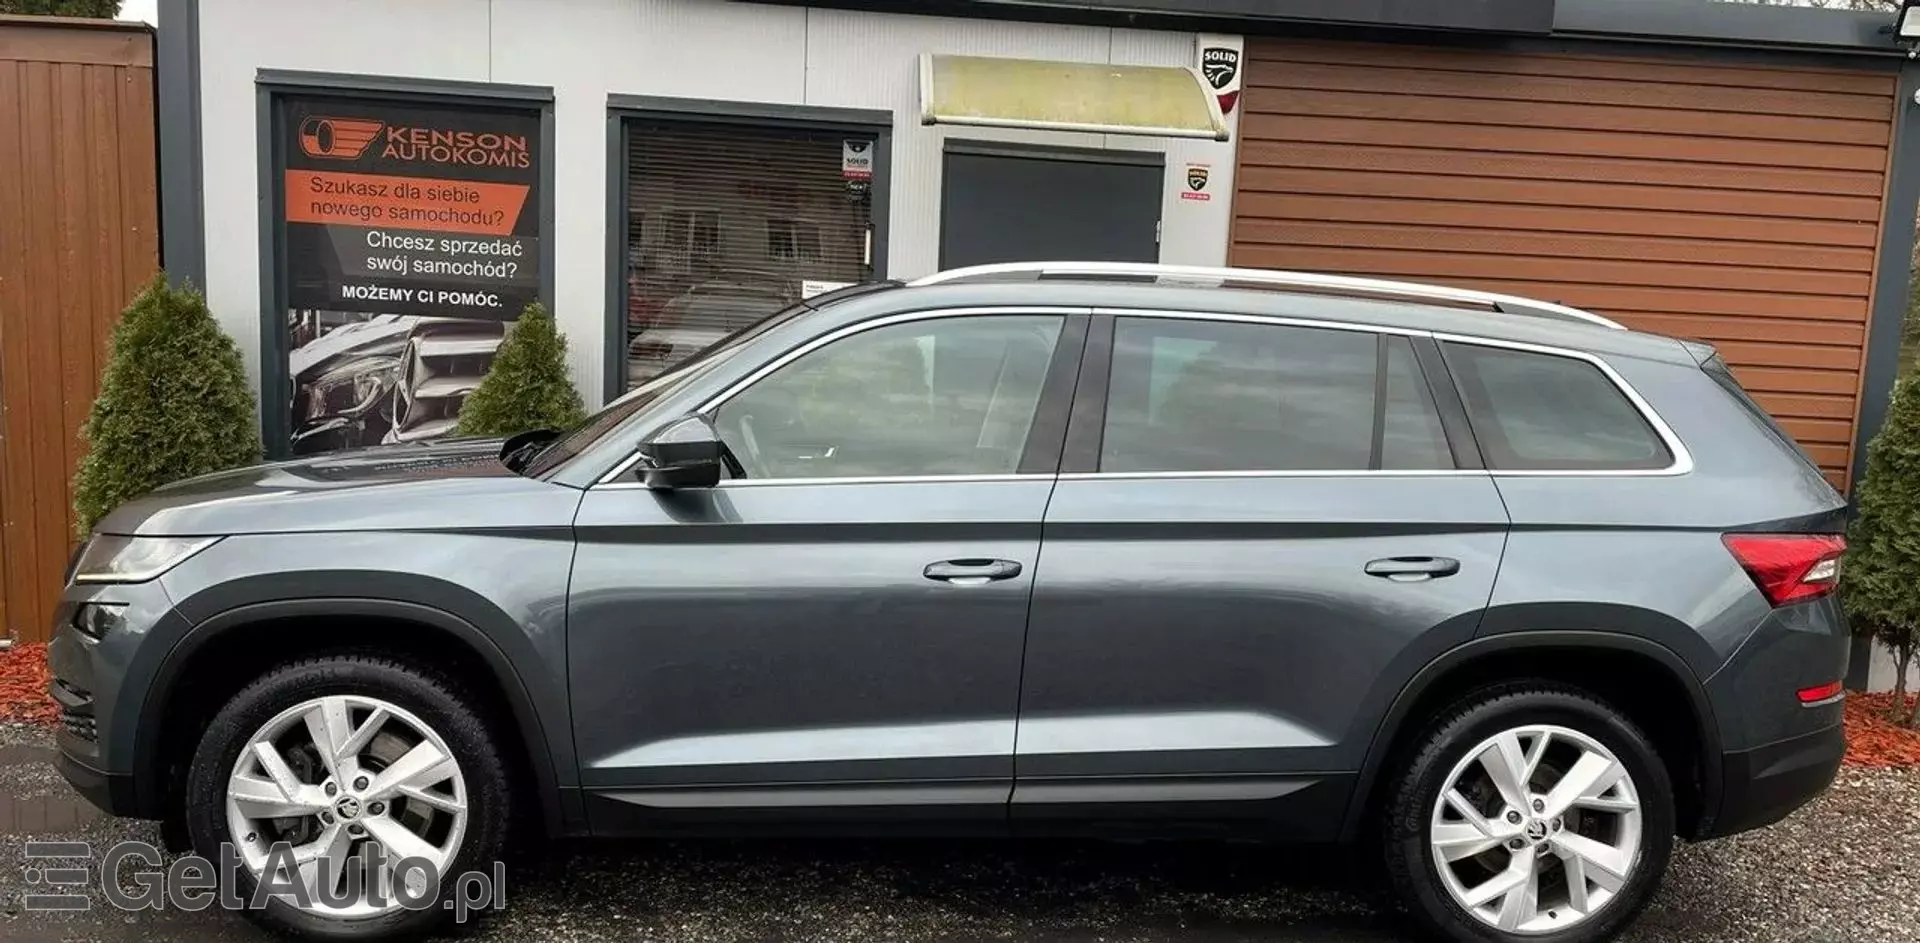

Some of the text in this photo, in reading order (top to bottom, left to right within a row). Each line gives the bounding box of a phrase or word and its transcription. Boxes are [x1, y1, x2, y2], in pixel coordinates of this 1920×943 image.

[1204, 51, 1237, 63] SOLID
[386, 126, 527, 151] KENSON
[381, 144, 530, 168] AUTOKOMIS
[310, 176, 480, 203] Szukasz dla siebie
[310, 200, 505, 227] nowego samochodu?
[366, 230, 523, 258] Chcesz sprzedać
[366, 255, 518, 279] swój samochód?
[341, 284, 503, 308] MOŻEMY CI POMÓC.
